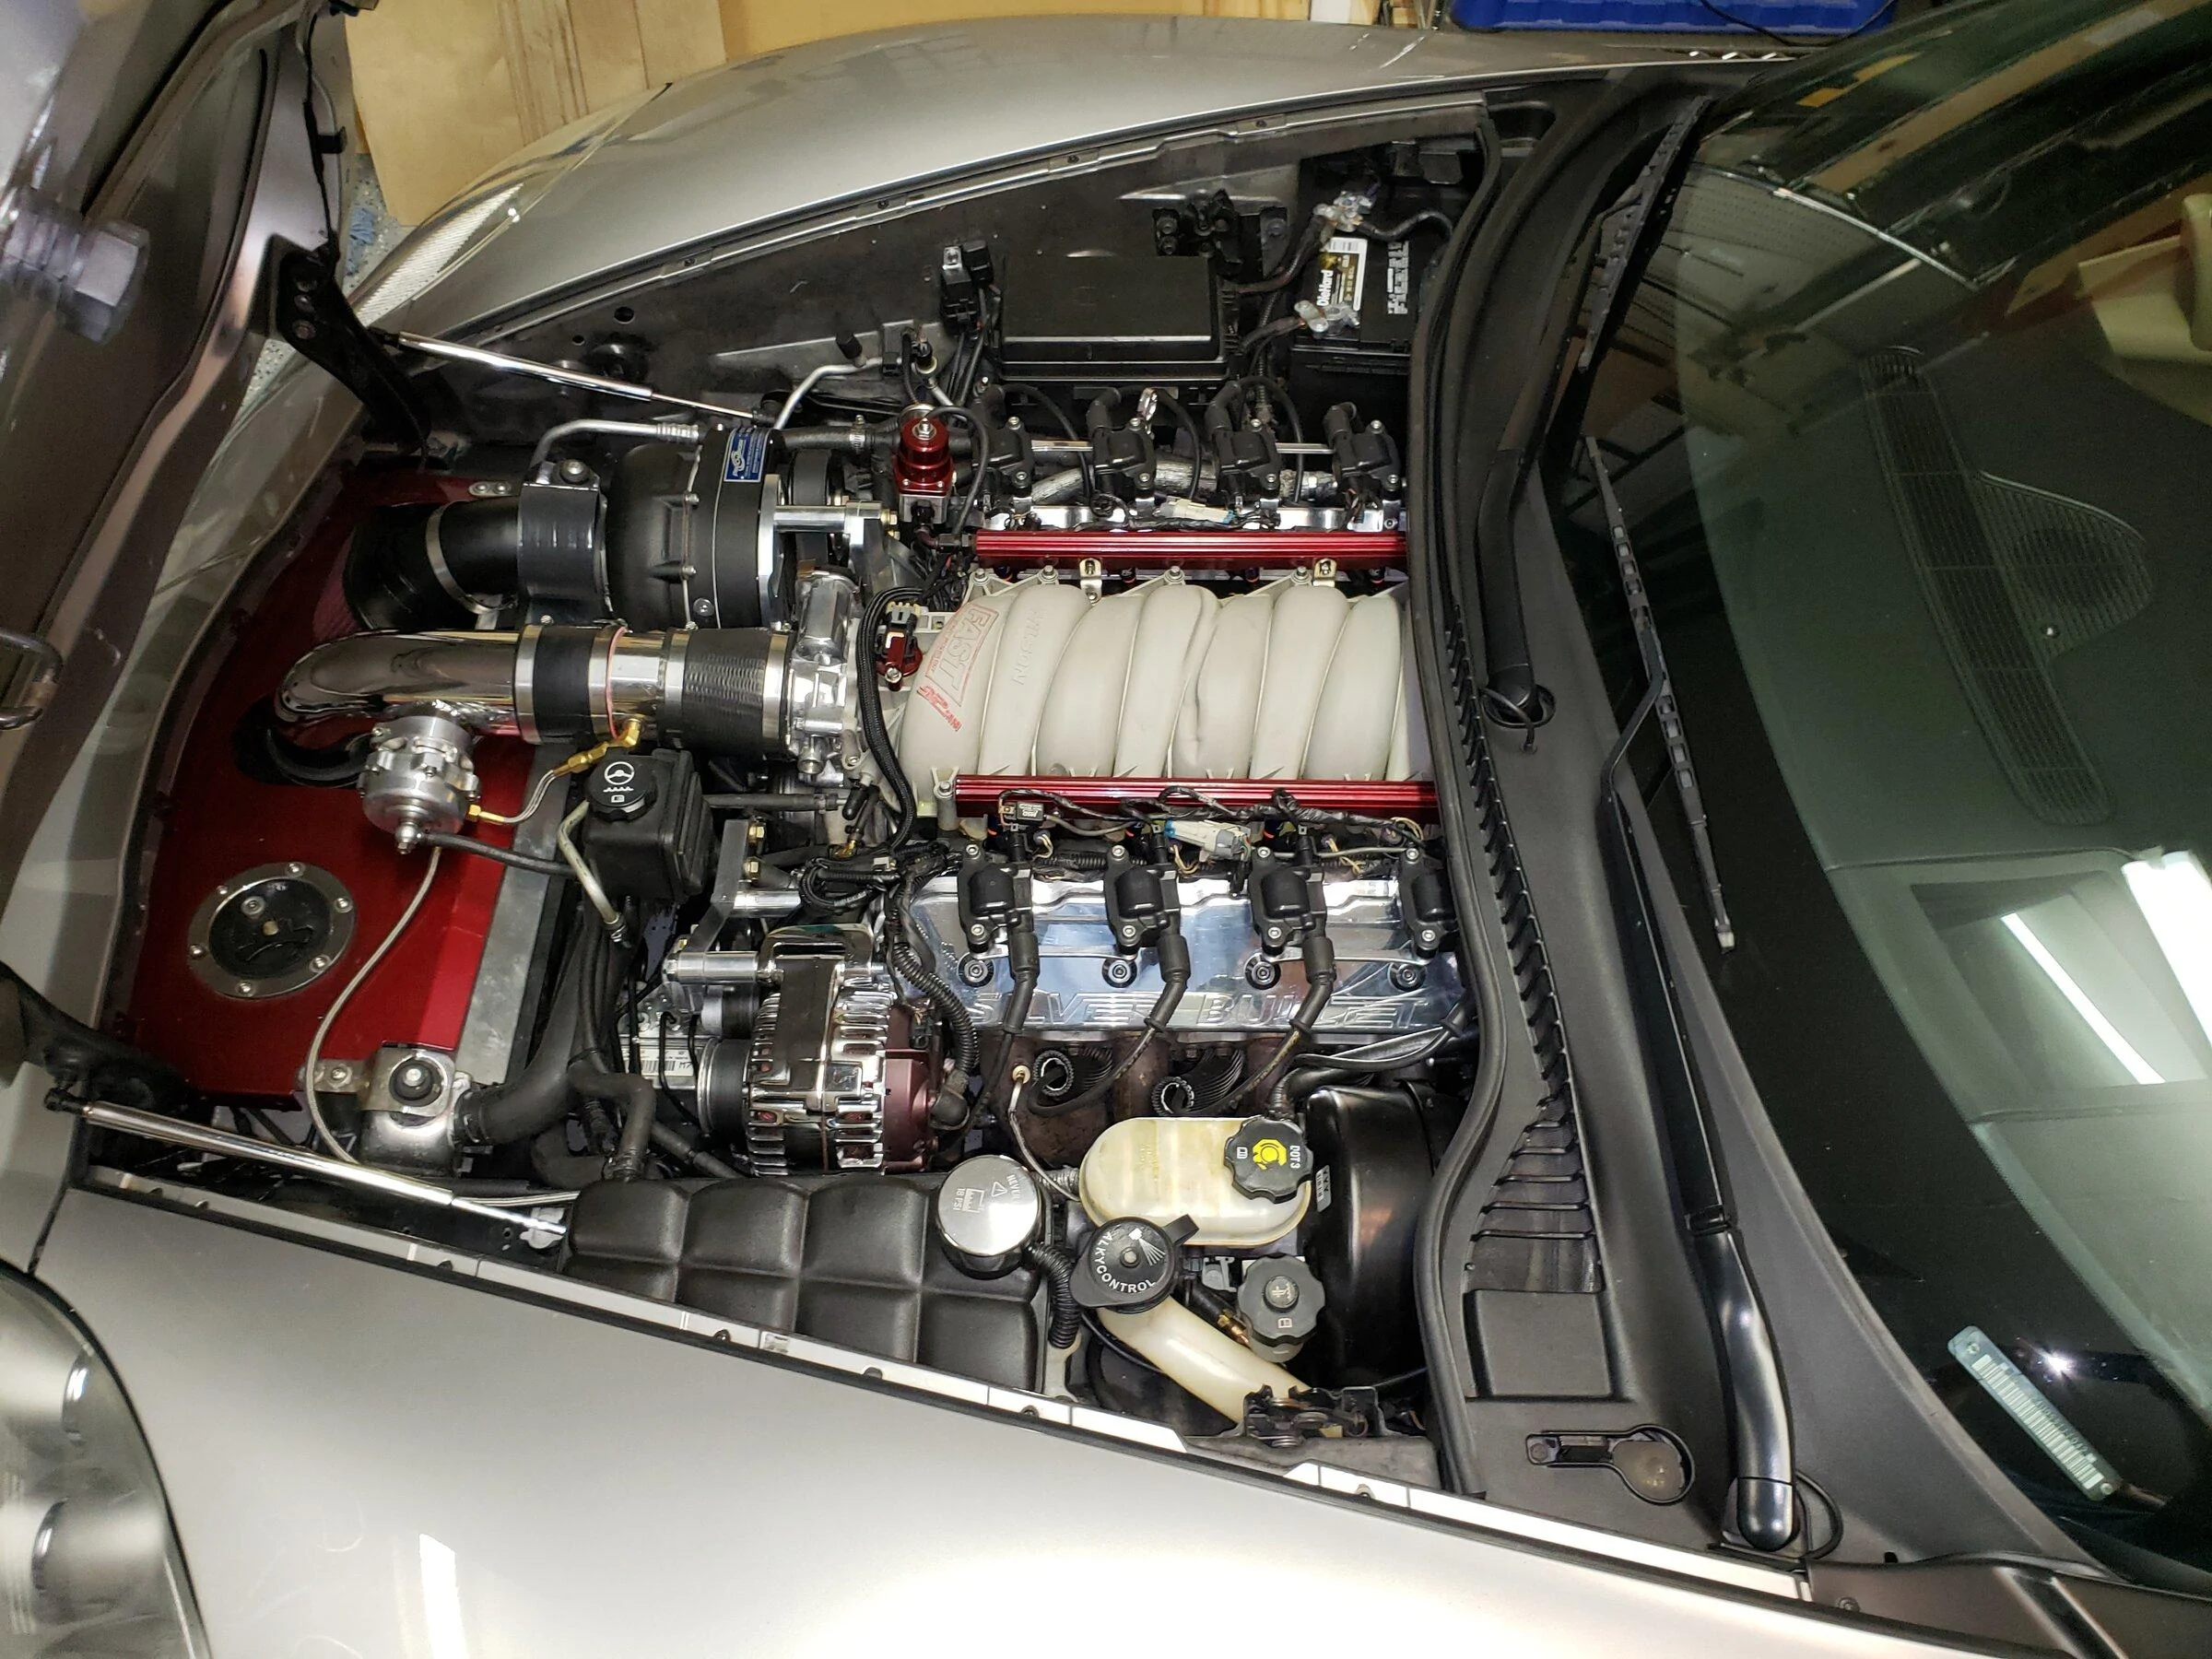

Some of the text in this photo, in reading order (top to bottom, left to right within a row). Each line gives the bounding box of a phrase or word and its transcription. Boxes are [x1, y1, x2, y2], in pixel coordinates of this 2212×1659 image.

[1316, 269, 1335, 306] DieHard
[939, 608, 992, 692] FAST
[953, 1197, 963, 1211] PSI
